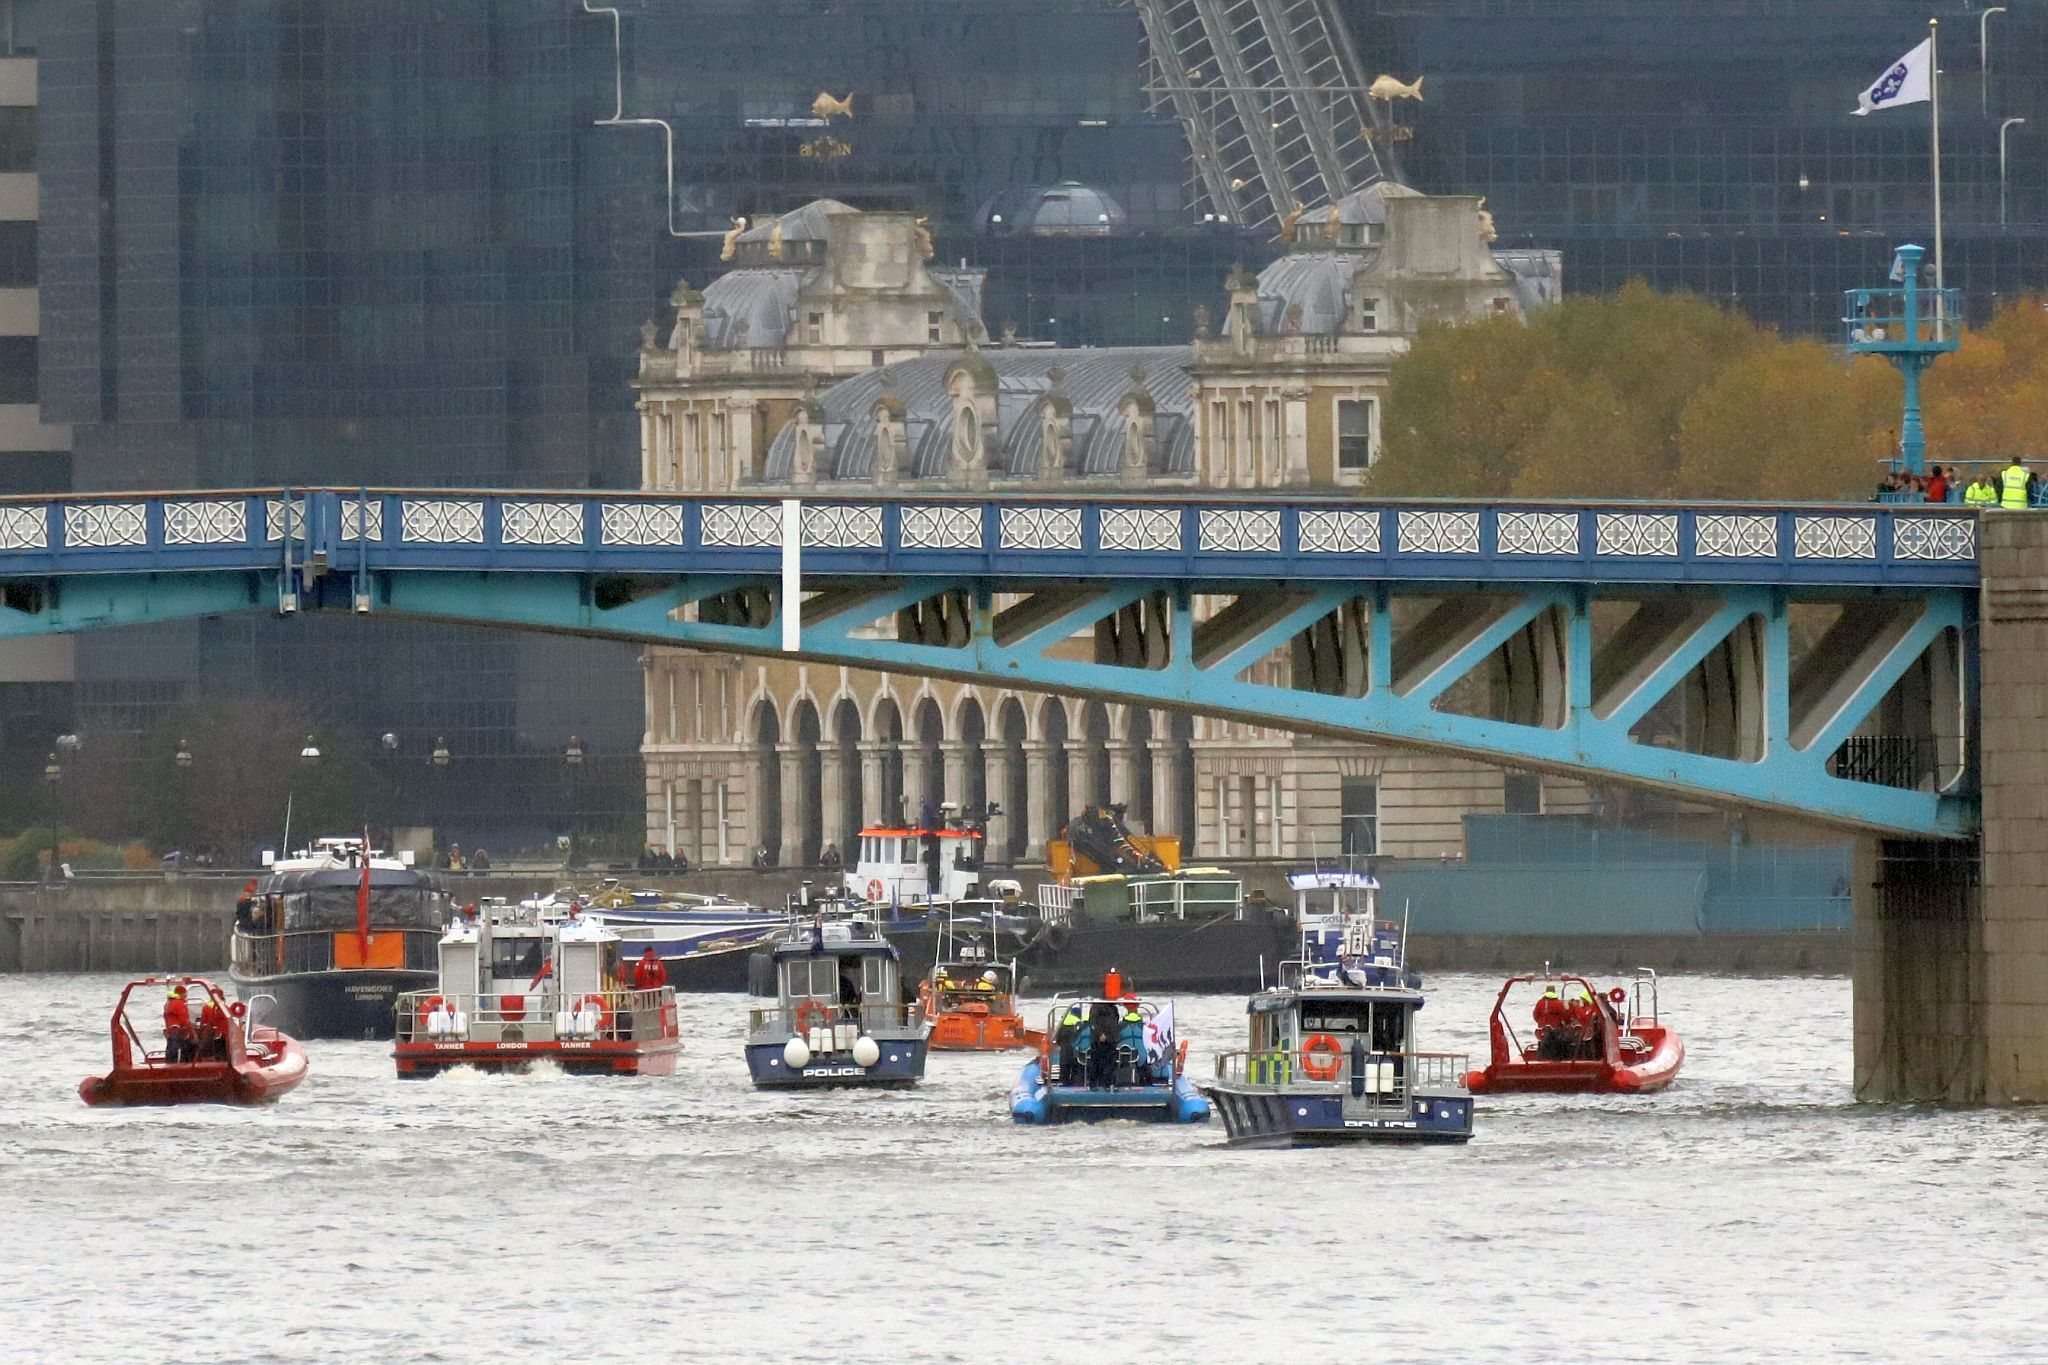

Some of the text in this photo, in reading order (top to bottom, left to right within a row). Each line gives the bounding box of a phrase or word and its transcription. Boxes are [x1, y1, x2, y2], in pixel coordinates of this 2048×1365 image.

[344, 985, 394, 993] HAVENGORE
[434, 1042, 465, 1050] TANNER
[496, 1042, 528, 1050] LONDON
[560, 1041, 591, 1049] TANNER
[802, 1067, 866, 1078] POLICE
